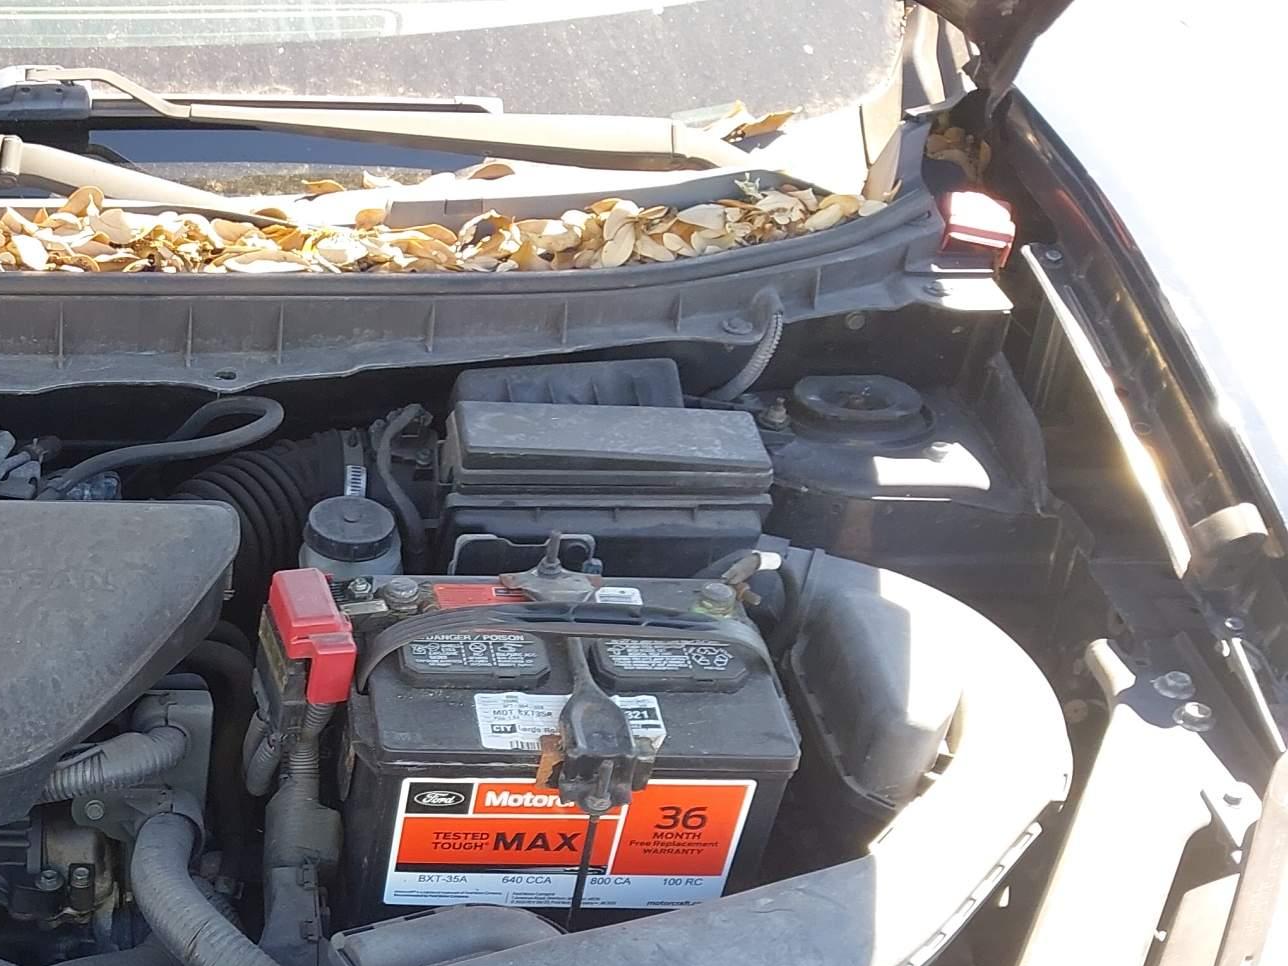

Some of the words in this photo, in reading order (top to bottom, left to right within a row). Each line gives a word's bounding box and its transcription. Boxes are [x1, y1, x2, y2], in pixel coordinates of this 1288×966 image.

[421, 792, 456, 804] Ford
[654, 806, 708, 830] 36
[433, 832, 489, 841] TESTED
[493, 832, 581, 852] MAX
[652, 832, 702, 840] MONTH
[418, 874, 468, 884] BXT-35A
[502, 876, 523, 884] 640
[525, 876, 552, 885] CCA
[590, 877, 611, 885] 800
[614, 877, 631, 885] CA
[663, 878, 682, 886] 100
[685, 878, 703, 886] RC
